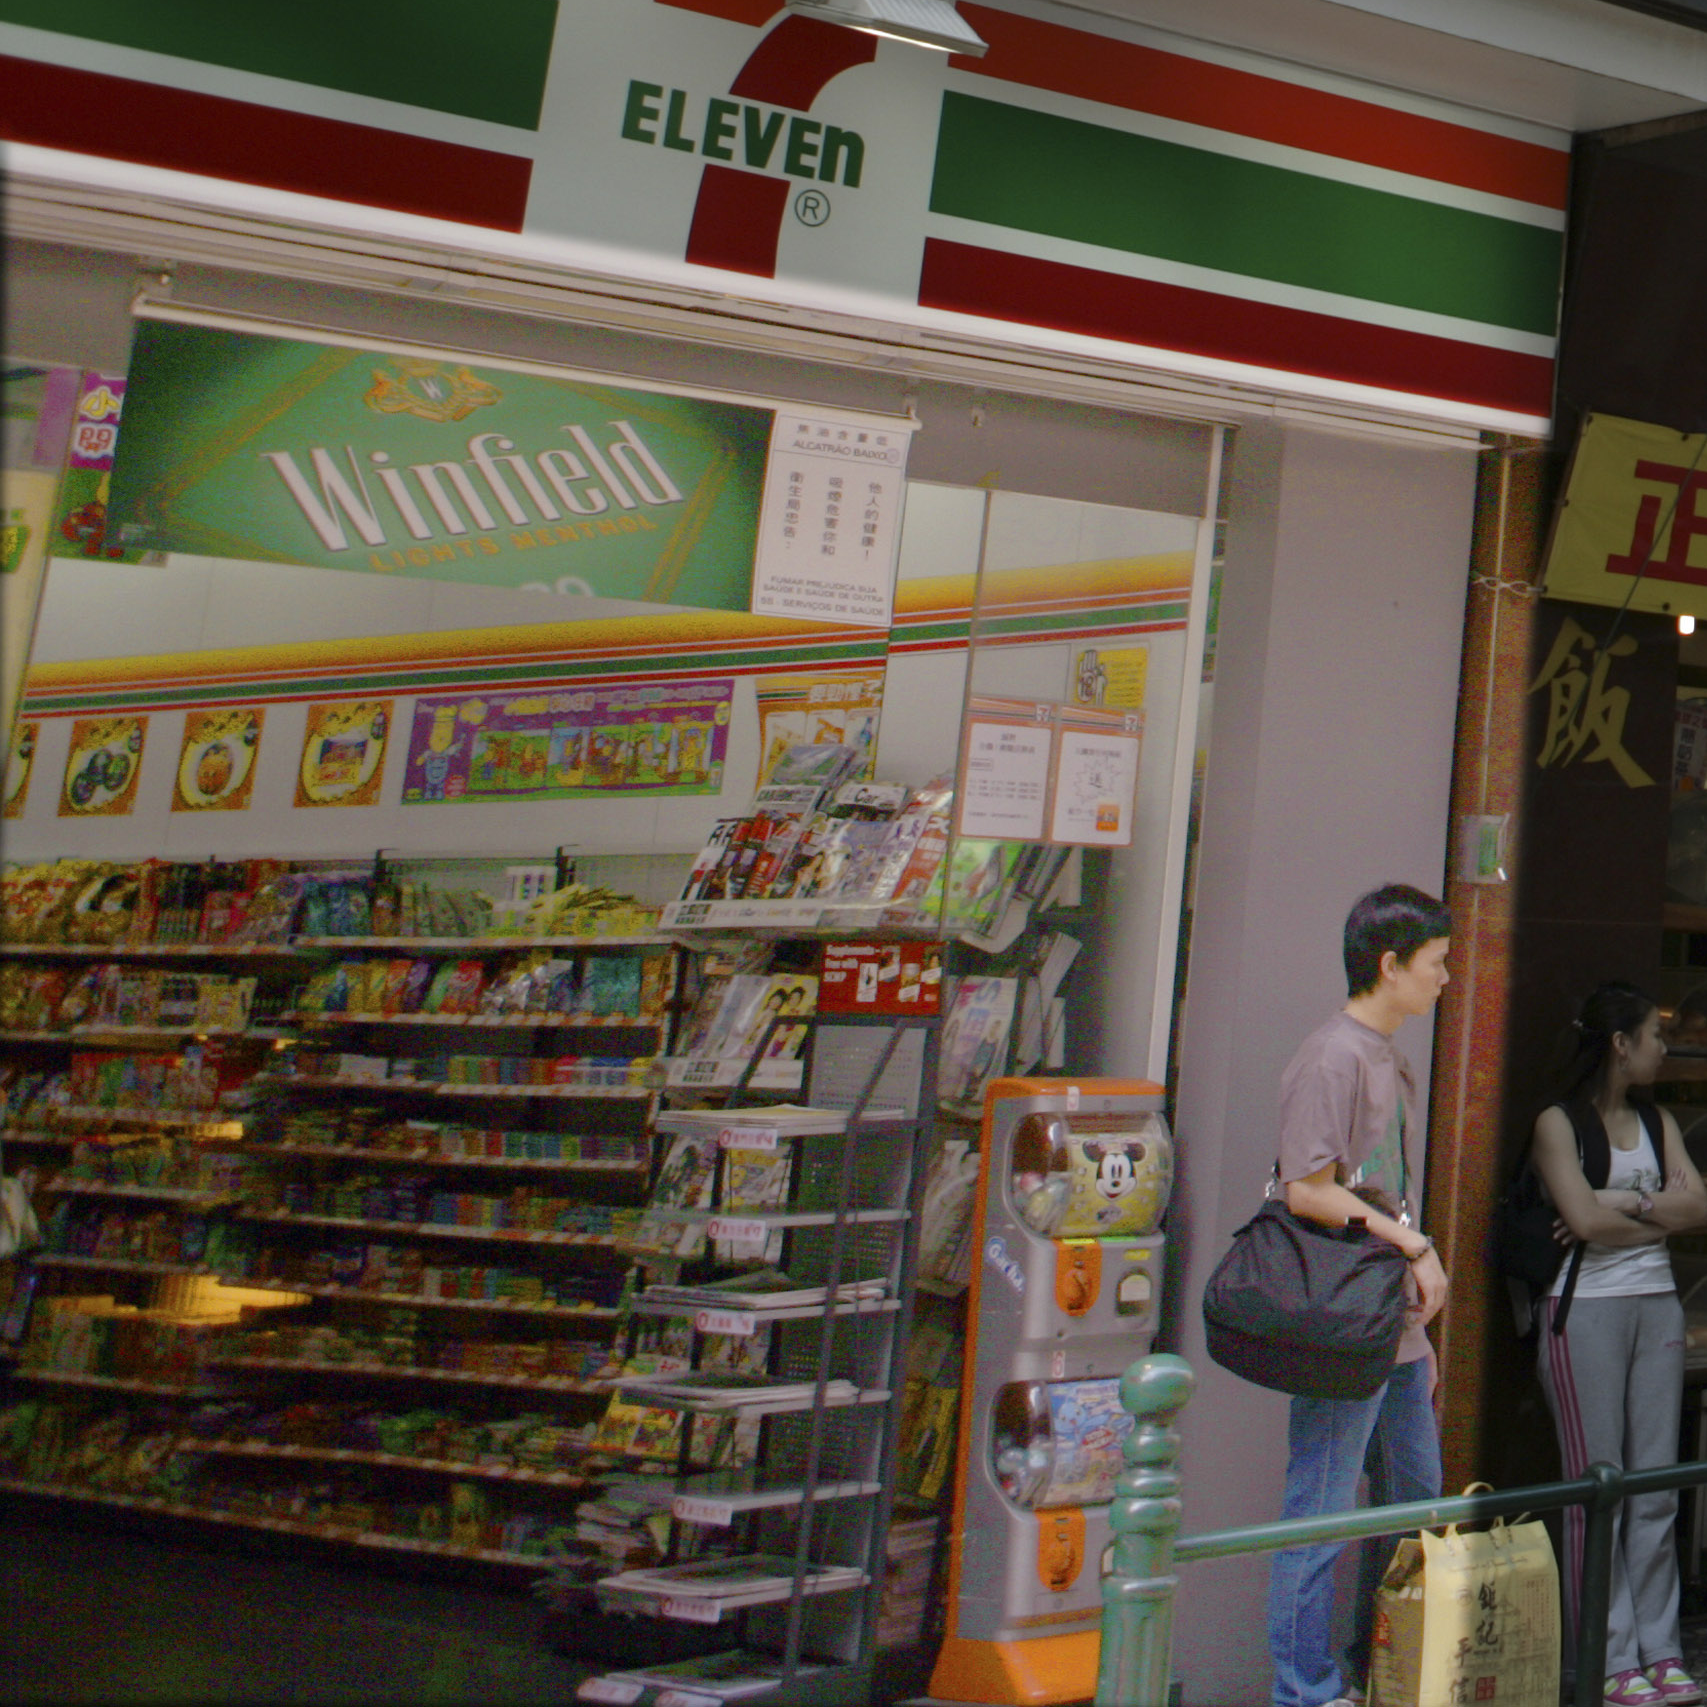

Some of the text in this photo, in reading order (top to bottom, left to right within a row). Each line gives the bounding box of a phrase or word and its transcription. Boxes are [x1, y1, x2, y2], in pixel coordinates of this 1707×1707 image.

[258, 419, 686, 552] Winfield
[368, 513, 660, 573] LIGHTS MENTHOL
[1531, 615, 1656, 789] 飯
